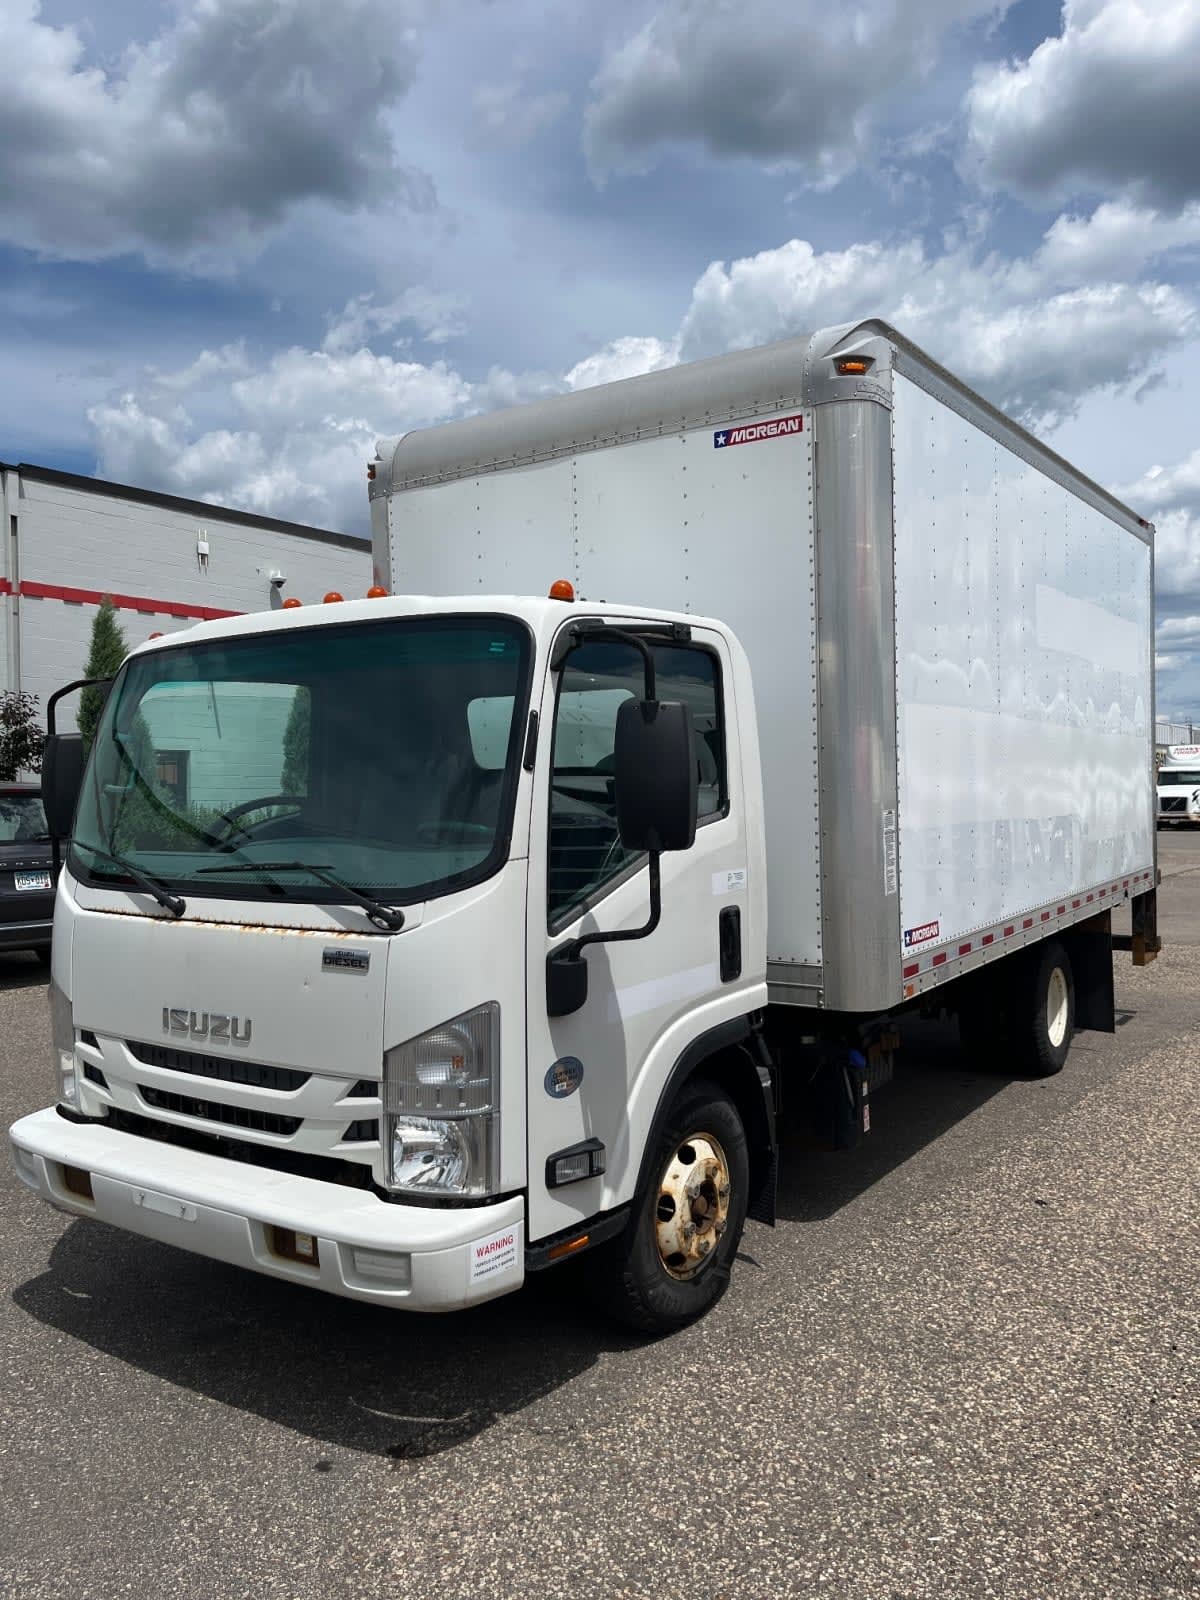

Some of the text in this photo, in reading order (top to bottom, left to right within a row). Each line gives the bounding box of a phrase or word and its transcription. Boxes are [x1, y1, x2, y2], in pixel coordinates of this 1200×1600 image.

[730, 419, 799, 443] MORGAN
[911, 923, 938, 943] MORGAN
[324, 957, 367, 969] DIESEL
[163, 1007, 252, 1046] ISUZU
[476, 1234, 514, 1257] WARNING
